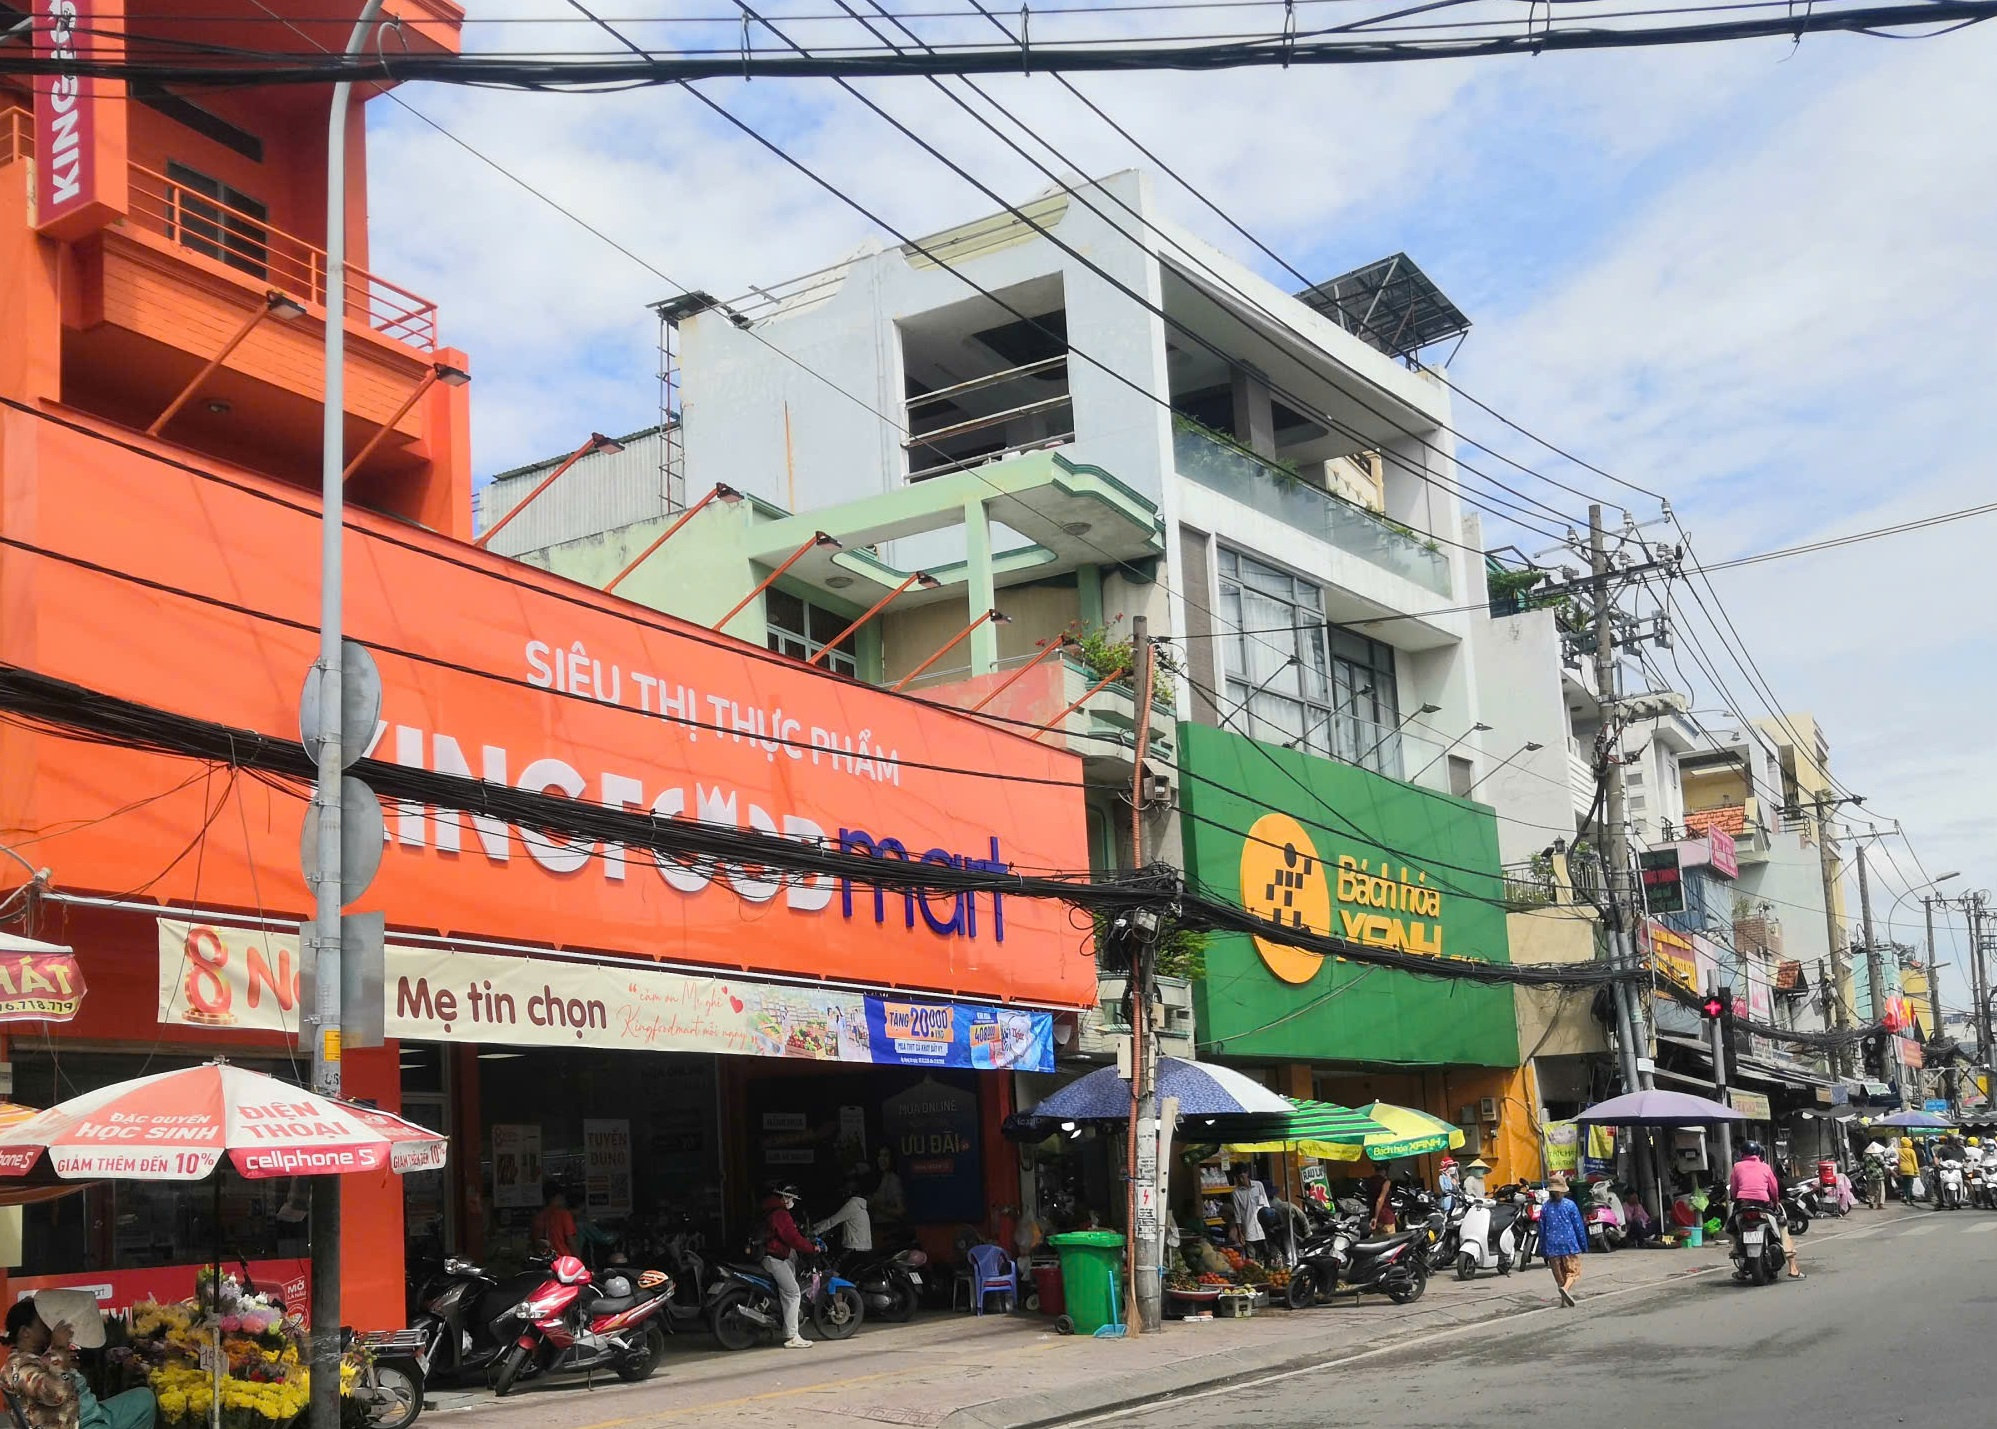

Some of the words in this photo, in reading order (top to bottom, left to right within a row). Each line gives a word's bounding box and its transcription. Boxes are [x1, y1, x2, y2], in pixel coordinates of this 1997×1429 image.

[525, 640, 621, 706] SIÊU
[630, 671, 698, 743] THỊ
[706, 694, 802, 763] THỰC
[810, 728, 900, 787] PHẨM
[1337, 855, 1397, 910] Bách
[1401, 867, 1440, 918] hóa
[396, 975, 458, 1034] Mẹ
[467, 980, 516, 1024] tin
[527, 984, 607, 1040] chọn
[889, 1009, 909, 1031] TẶNG
[110, 1112, 148, 1124] ĐẶC
[237, 1101, 320, 1121] ĐIỆN
[75, 1122, 141, 1141] HỌC
[144, 1125, 219, 1140] SINH
[242, 1121, 351, 1139] THOẠI
[57, 1153, 92, 1173] GIẢM
[97, 1154, 136, 1172] THÊM
[140, 1154, 168, 1172] ĐẾN
[175, 1152, 214, 1174] 10%
[287, 1279, 305, 1294] MỞ
